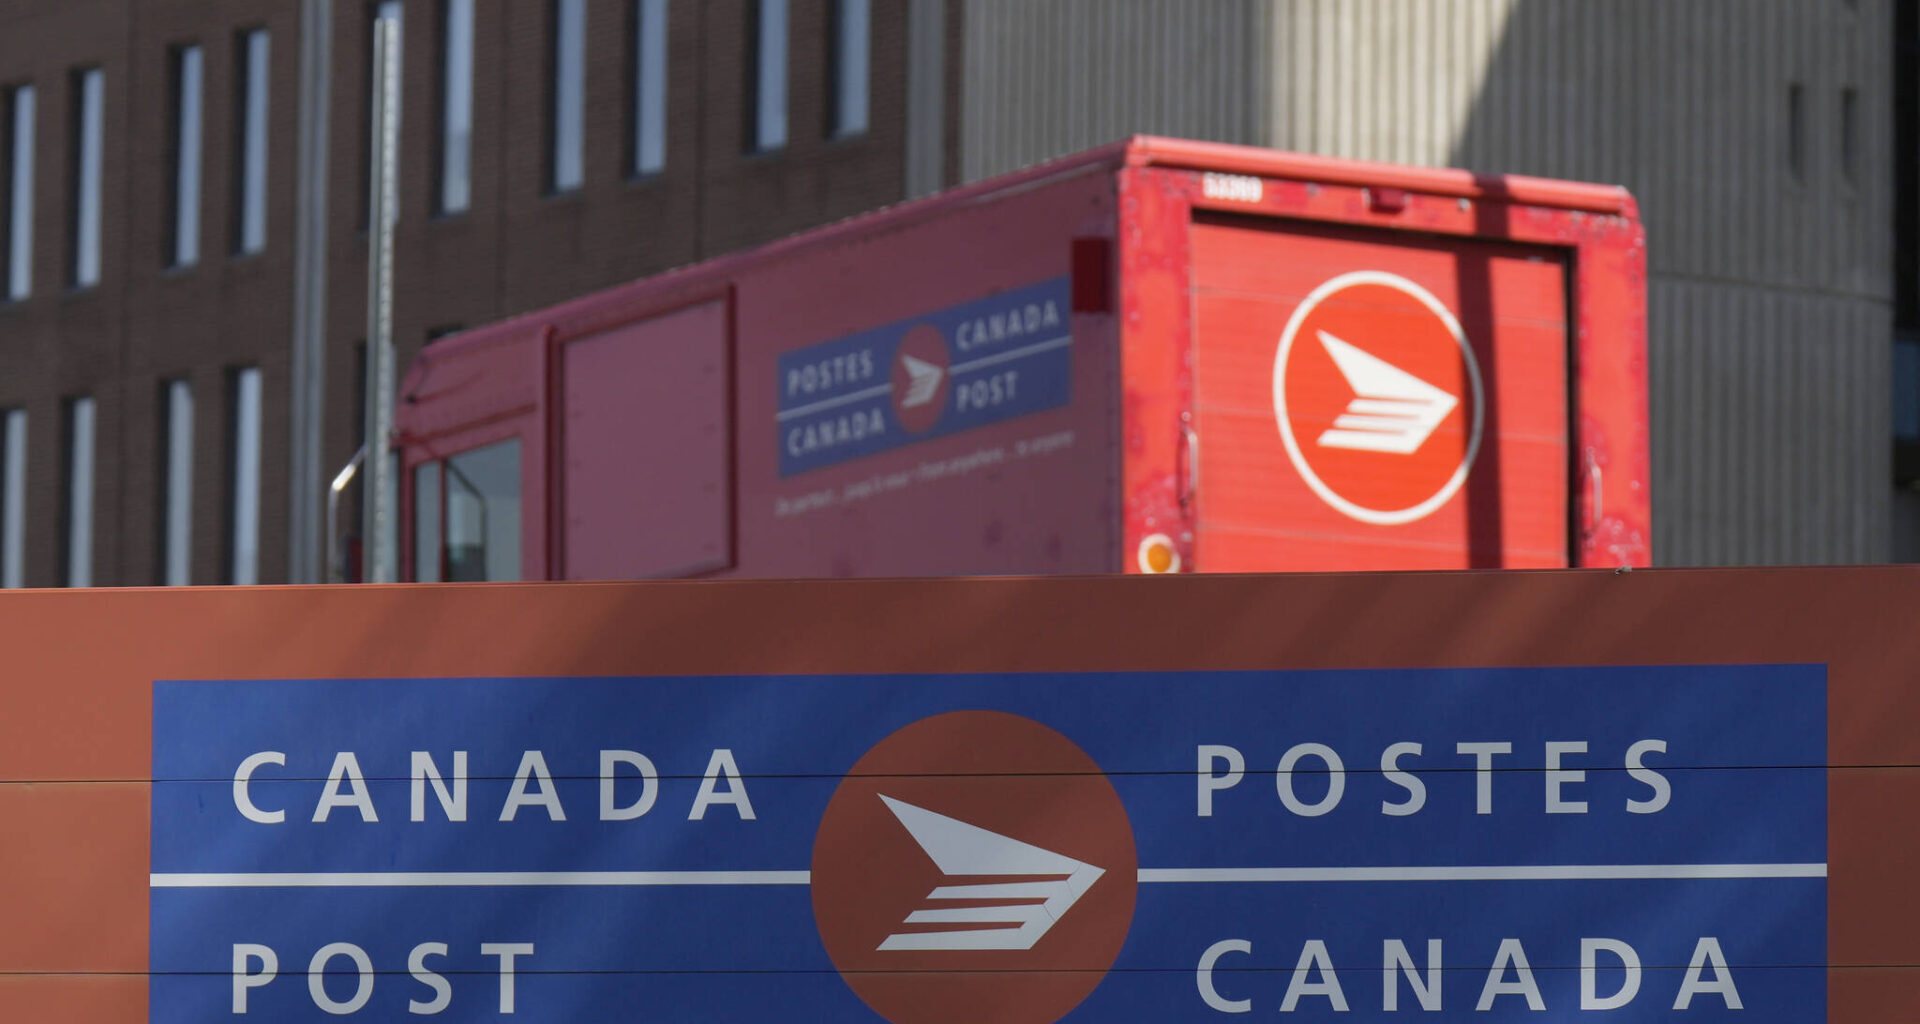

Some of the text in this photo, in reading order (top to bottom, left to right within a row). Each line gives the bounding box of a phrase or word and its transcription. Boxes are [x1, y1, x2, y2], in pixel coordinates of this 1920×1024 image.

[955, 299, 1060, 351] CANADA
[787, 349, 874, 397] POSTES
[956, 370, 1019, 413] POST
[787, 407, 886, 458] CANADA
[232, 749, 757, 824] CANADA
[1197, 739, 1672, 817] POSTES
[232, 942, 535, 1015] POST
[1196, 937, 1744, 1013] CANADA
